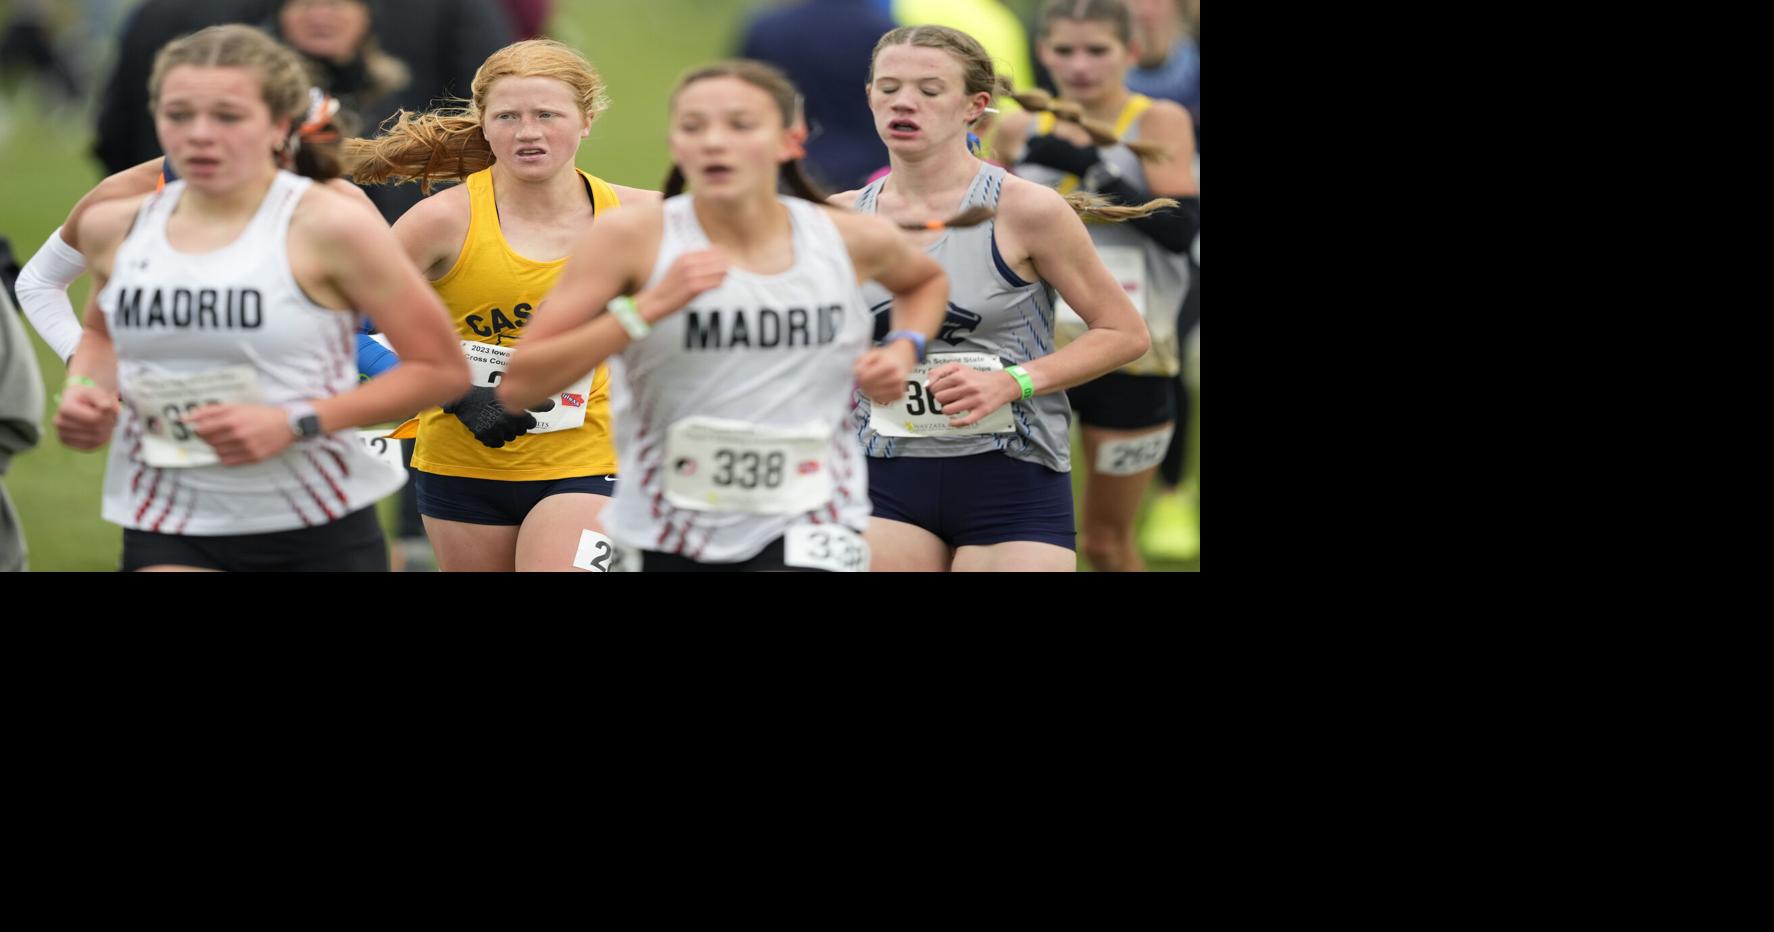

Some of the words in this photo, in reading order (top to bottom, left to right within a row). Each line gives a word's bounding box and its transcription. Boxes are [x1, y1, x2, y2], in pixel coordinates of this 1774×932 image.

[115, 286, 263, 329] MADRID
[471, 345, 490, 353] 2023
[712, 449, 786, 490] 338
